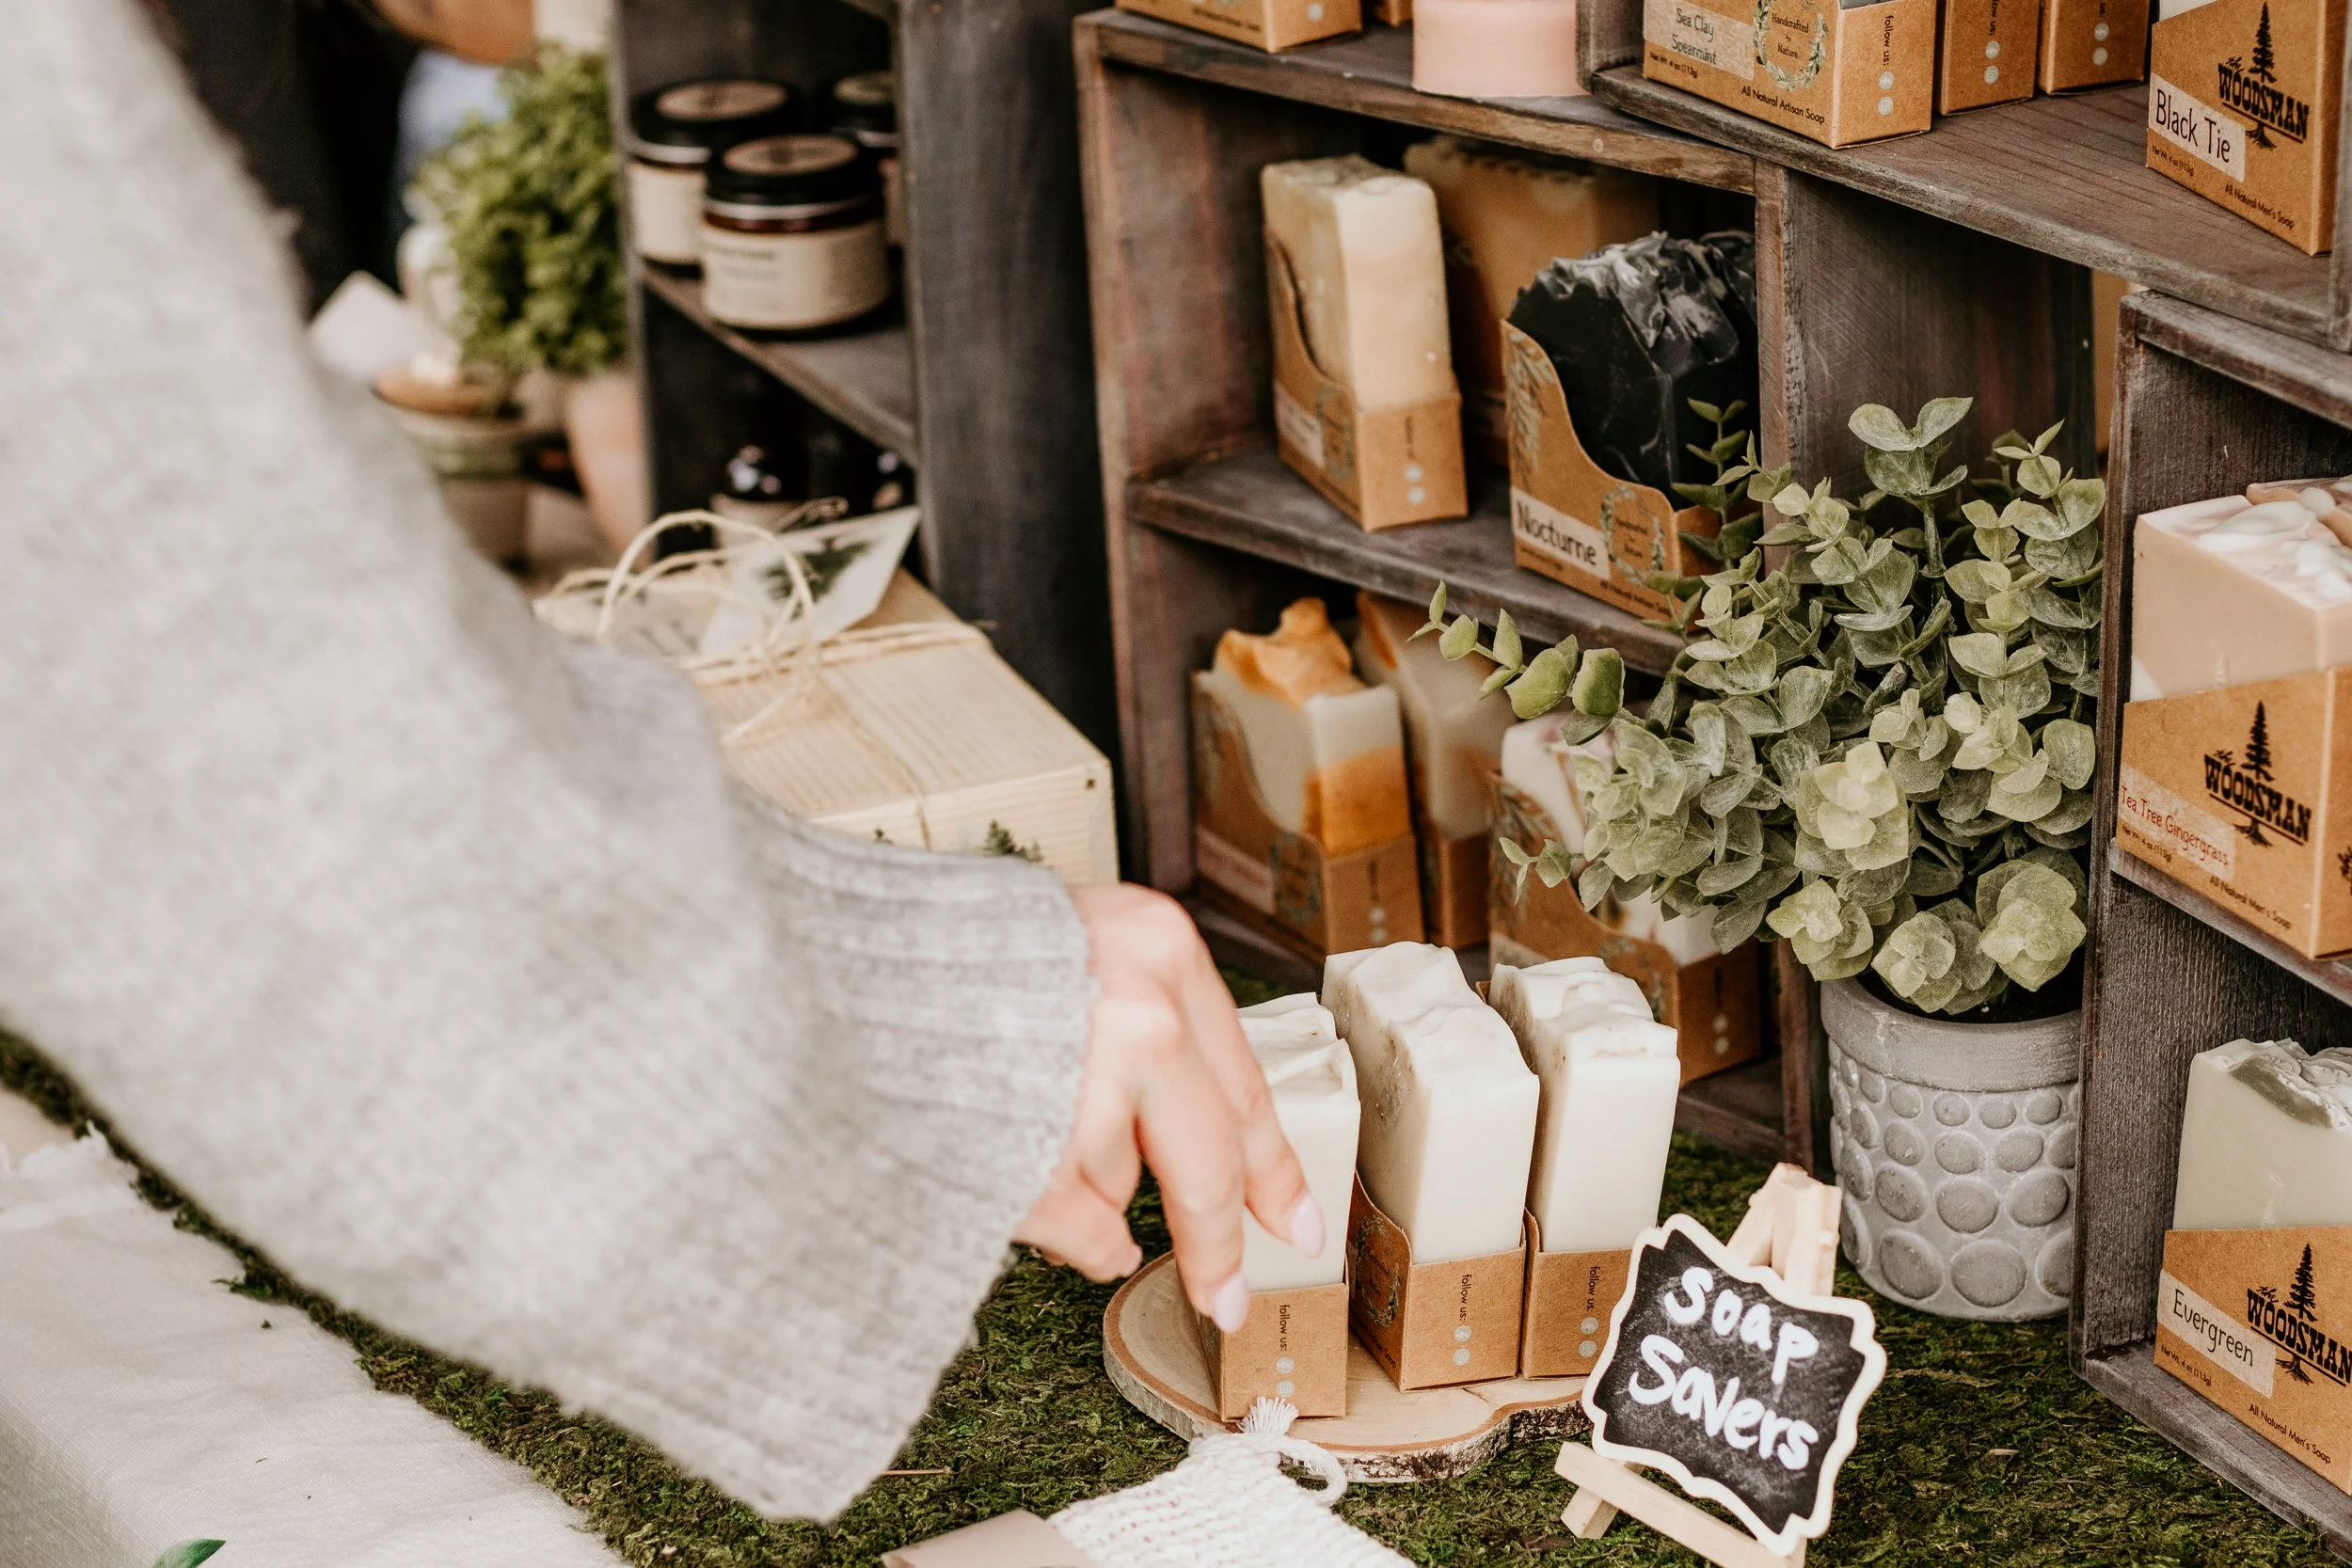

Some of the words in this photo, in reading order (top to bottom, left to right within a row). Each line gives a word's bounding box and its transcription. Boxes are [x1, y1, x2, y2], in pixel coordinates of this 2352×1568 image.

[1677, 8, 1692, 28] Sea
[1694, 14, 1714, 43] Clay
[1772, 13, 1809, 33] Handcrafted
[1884, 15, 1894, 47] follow
[1672, 33, 1716, 65] Spearmint
[1777, 43, 1798, 59] Nature
[1741, 85, 1751, 97] All
[1753, 89, 1777, 106] Natural
[1780, 99, 1804, 117] Artisan
[1806, 108, 1825, 125] Soap
[2217, 62, 2310, 140] WOODSMAN
[2155, 87, 2199, 148] Black
[2203, 117, 2232, 164] Tie
[1517, 499, 1597, 566] Nocturne
[2203, 753, 2312, 843] WOODSMAN
[2121, 784, 2137, 813] Tea
[2140, 798, 2162, 827] Tree
[2166, 815, 2229, 866] Gingergrass
[1461, 1274, 1472, 1305] follow
[1588, 1265, 1600, 1296] follow
[1279, 1304, 1291, 1335] follow
[1586, 1298, 1595, 1312] us:
[1663, 1266, 1820, 1385] Soap
[2173, 1288, 2254, 1368] Evergreen
[2247, 1287, 2352, 1385] WOODSMAN
[2186, 1365, 2192, 1373] oz
[2194, 1368, 2211, 1386] (113g)
[1629, 1334, 1820, 1470] Savers
[2249, 1403, 2259, 1417] All
[2261, 1410, 2286, 1434] Natural
[2289, 1429, 2310, 1450] Men's
[2312, 1444, 2330, 1465] Soap
